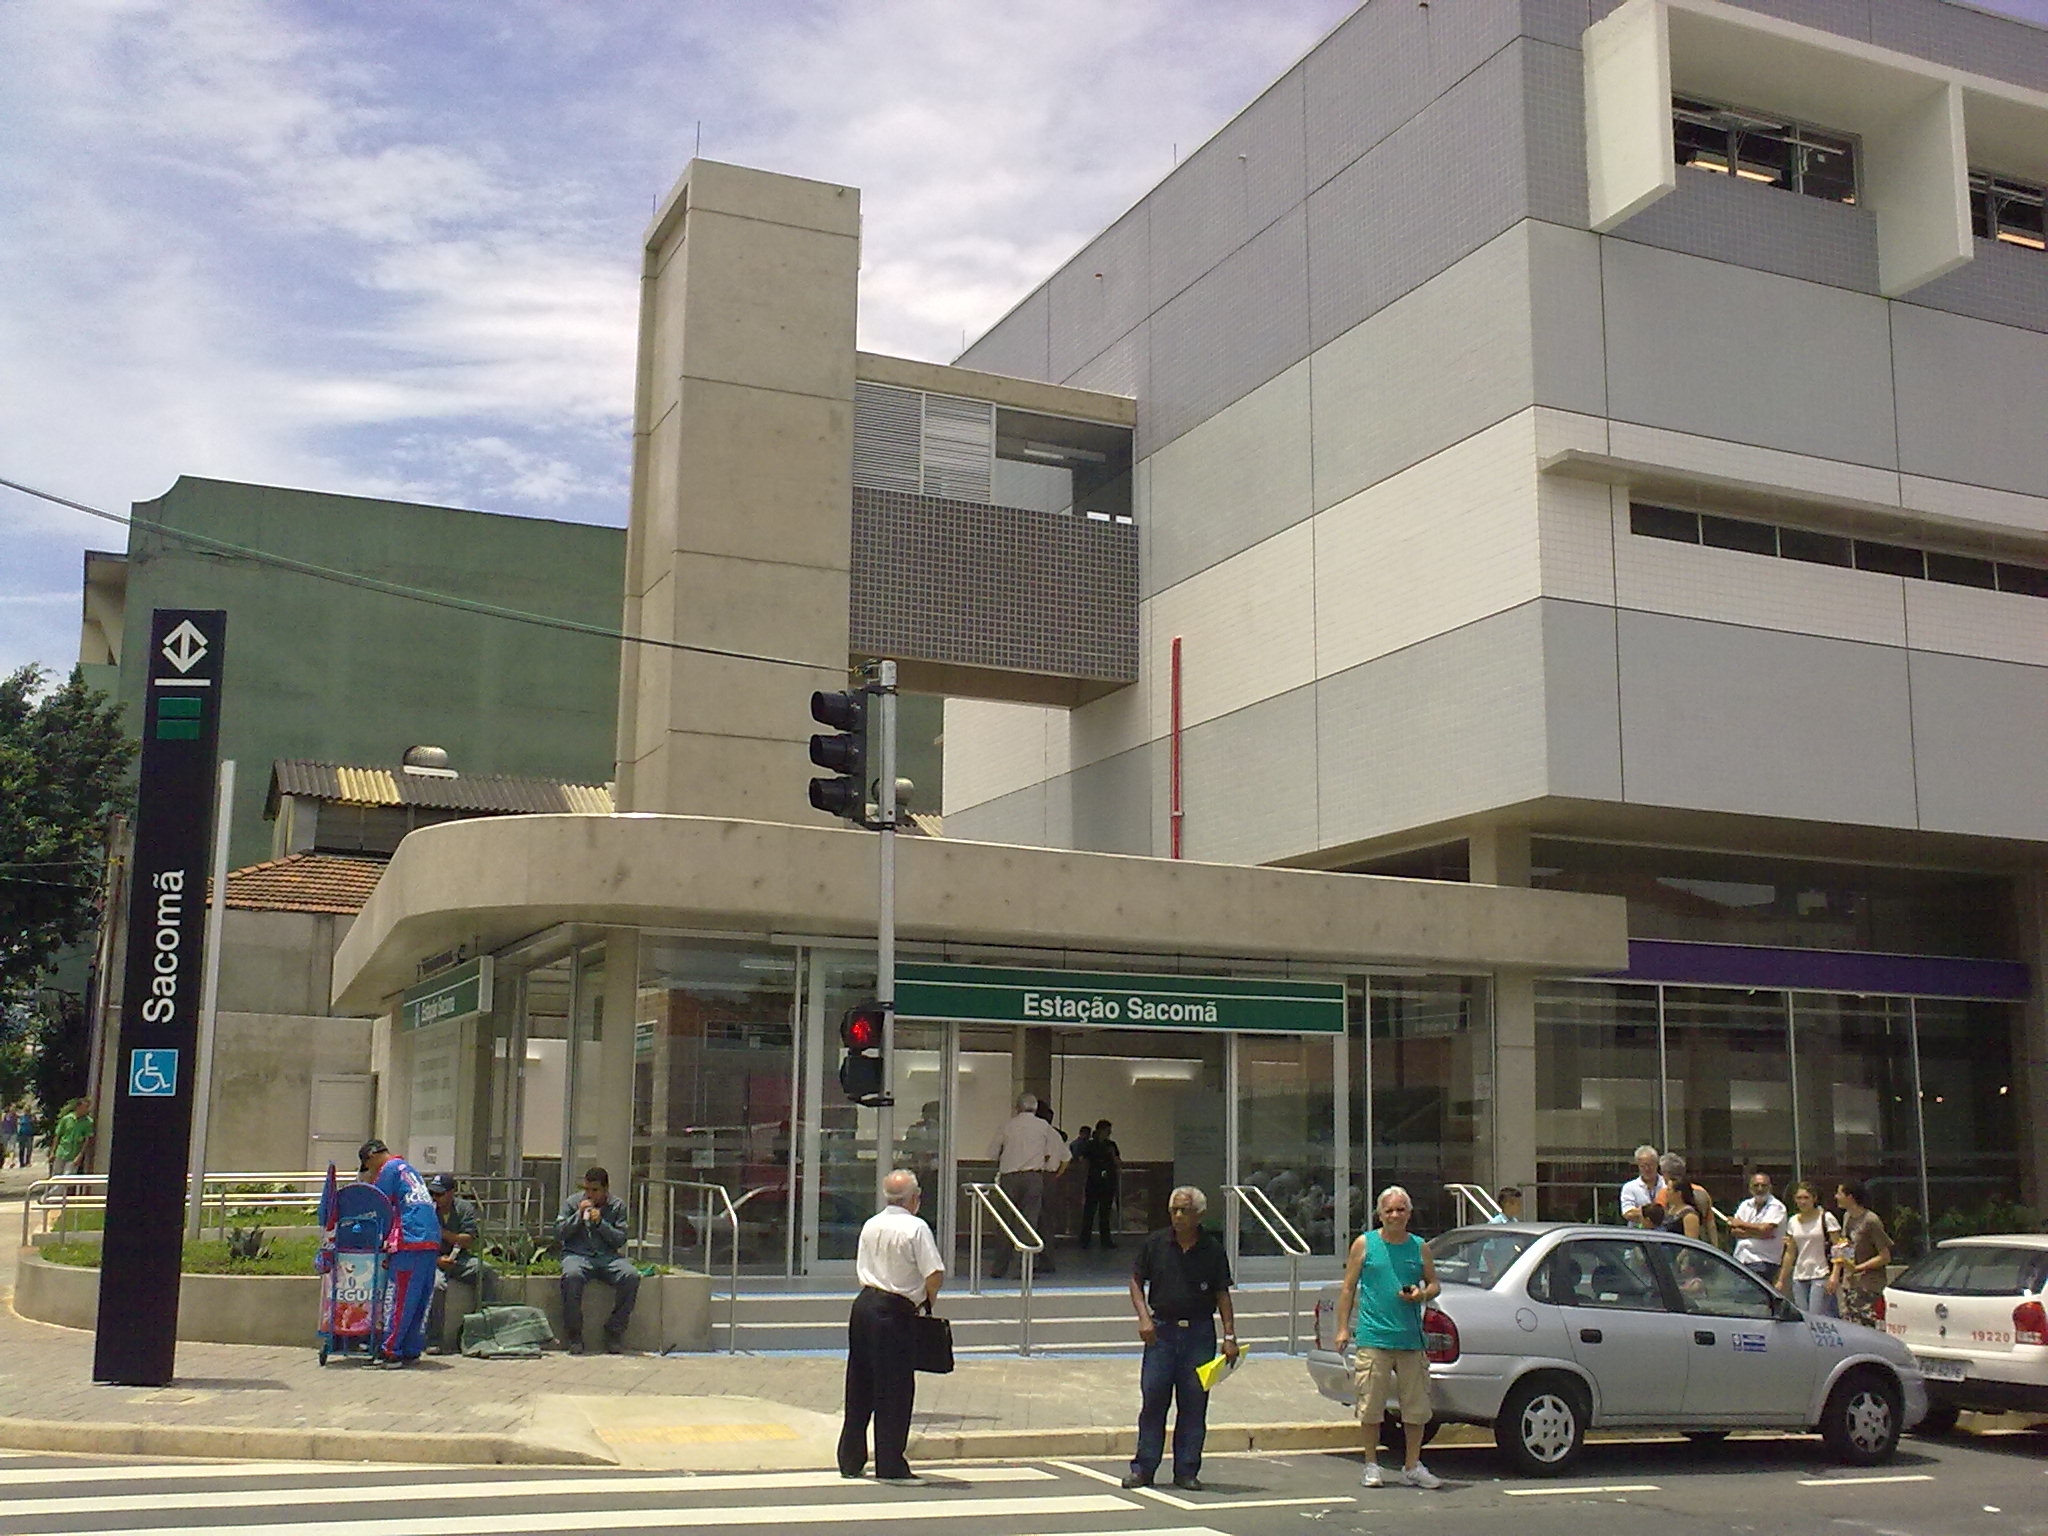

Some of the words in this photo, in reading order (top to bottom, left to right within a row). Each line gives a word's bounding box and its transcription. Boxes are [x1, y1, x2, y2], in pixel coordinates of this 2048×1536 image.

[142, 869, 185, 1024] Sacomã
[1023, 992, 1121, 1023] Estação
[1126, 996, 1218, 1022] Sacomã
[1972, 1331, 2010, 1343] 19220
